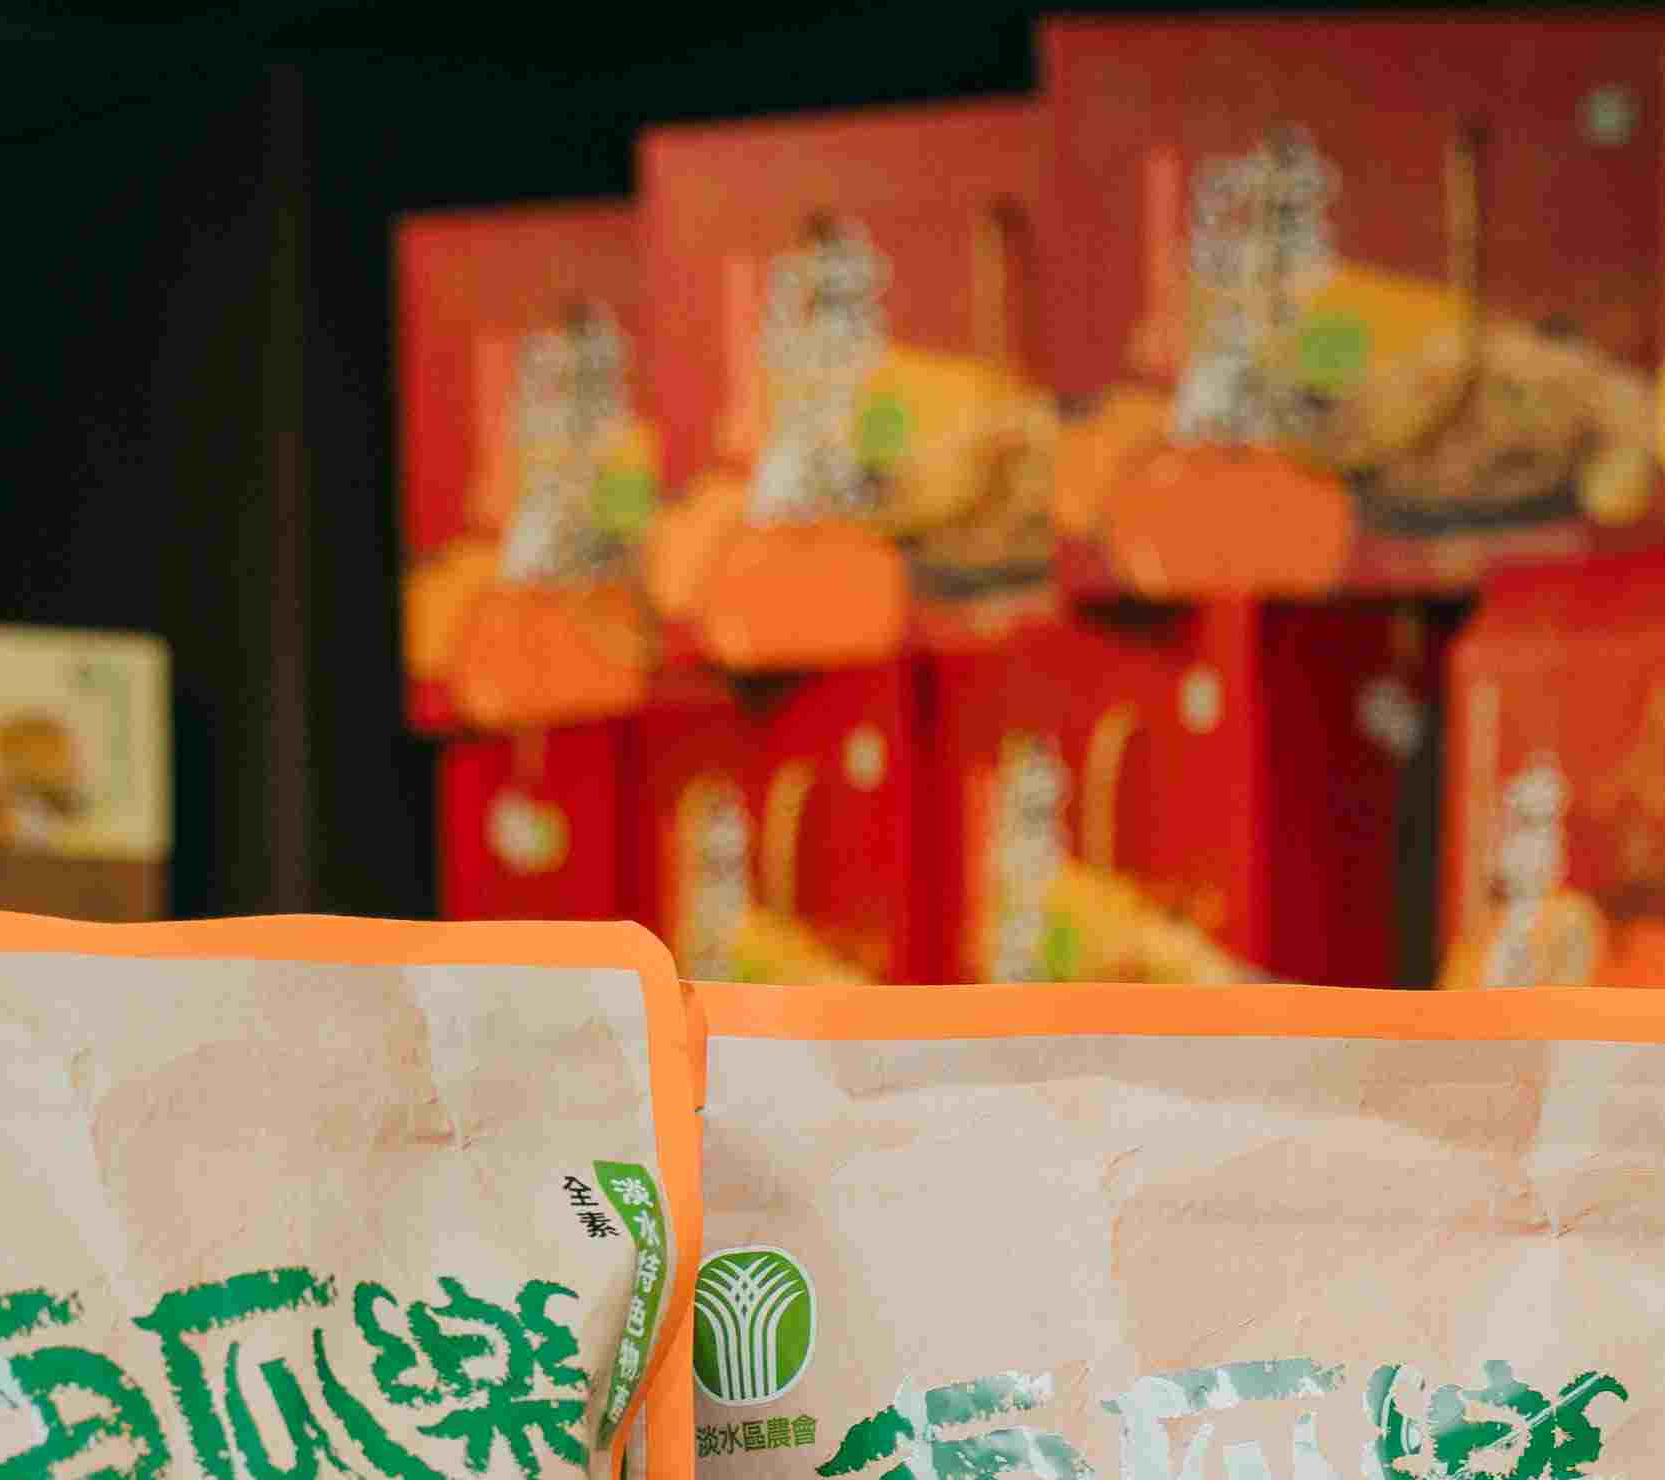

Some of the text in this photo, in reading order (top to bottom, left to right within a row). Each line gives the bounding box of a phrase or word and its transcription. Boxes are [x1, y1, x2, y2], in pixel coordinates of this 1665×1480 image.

[561, 1174, 621, 1239] 全素
[695, 1411, 819, 1458] 淡水區農會
